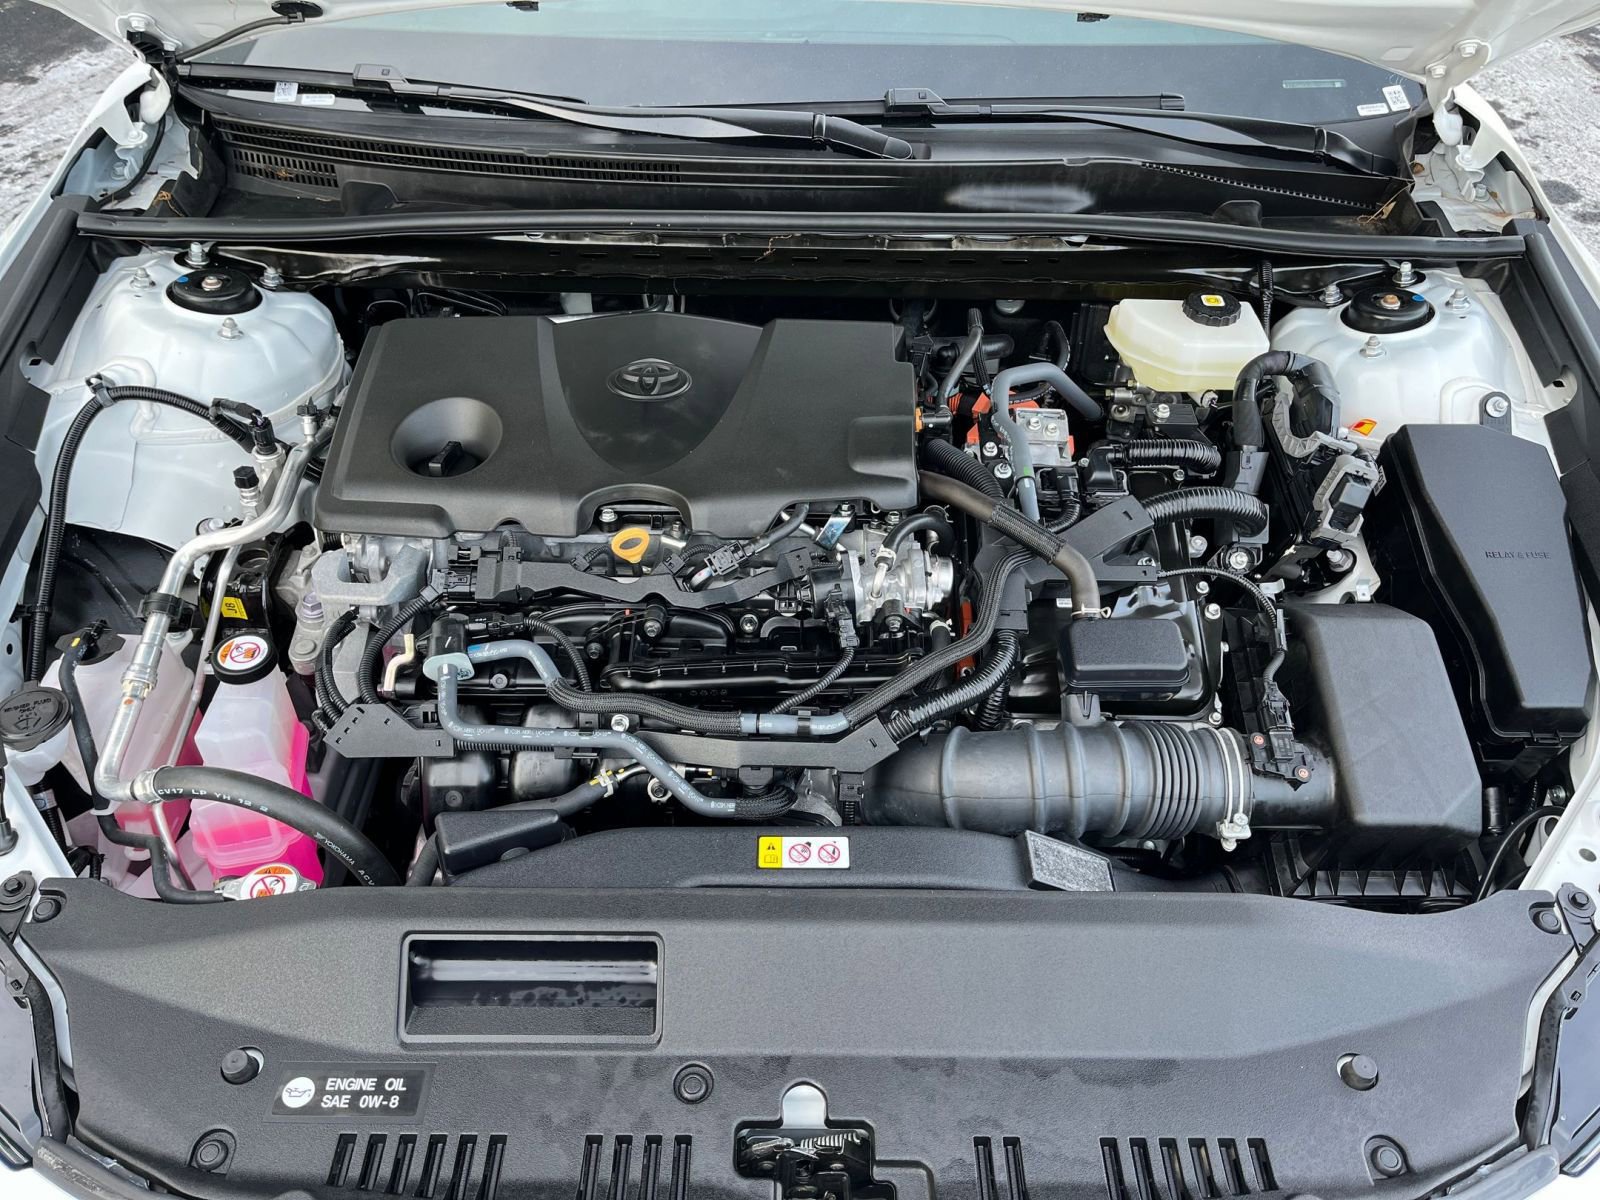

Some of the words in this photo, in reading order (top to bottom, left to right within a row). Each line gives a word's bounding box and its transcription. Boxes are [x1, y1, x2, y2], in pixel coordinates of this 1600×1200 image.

[1485, 551, 1515, 559] RELAY
[1525, 551, 1552, 560] FUSE
[157, 788, 184, 796] CV17
[214, 792, 231, 801] YH
[324, 839, 356, 866] YOKOHAMA
[358, 869, 375, 887] ACV
[325, 1078, 378, 1091] ENGINE
[384, 1077, 407, 1091] OIL
[320, 1094, 352, 1108] SAE
[359, 1094, 400, 1109] 0W-8
